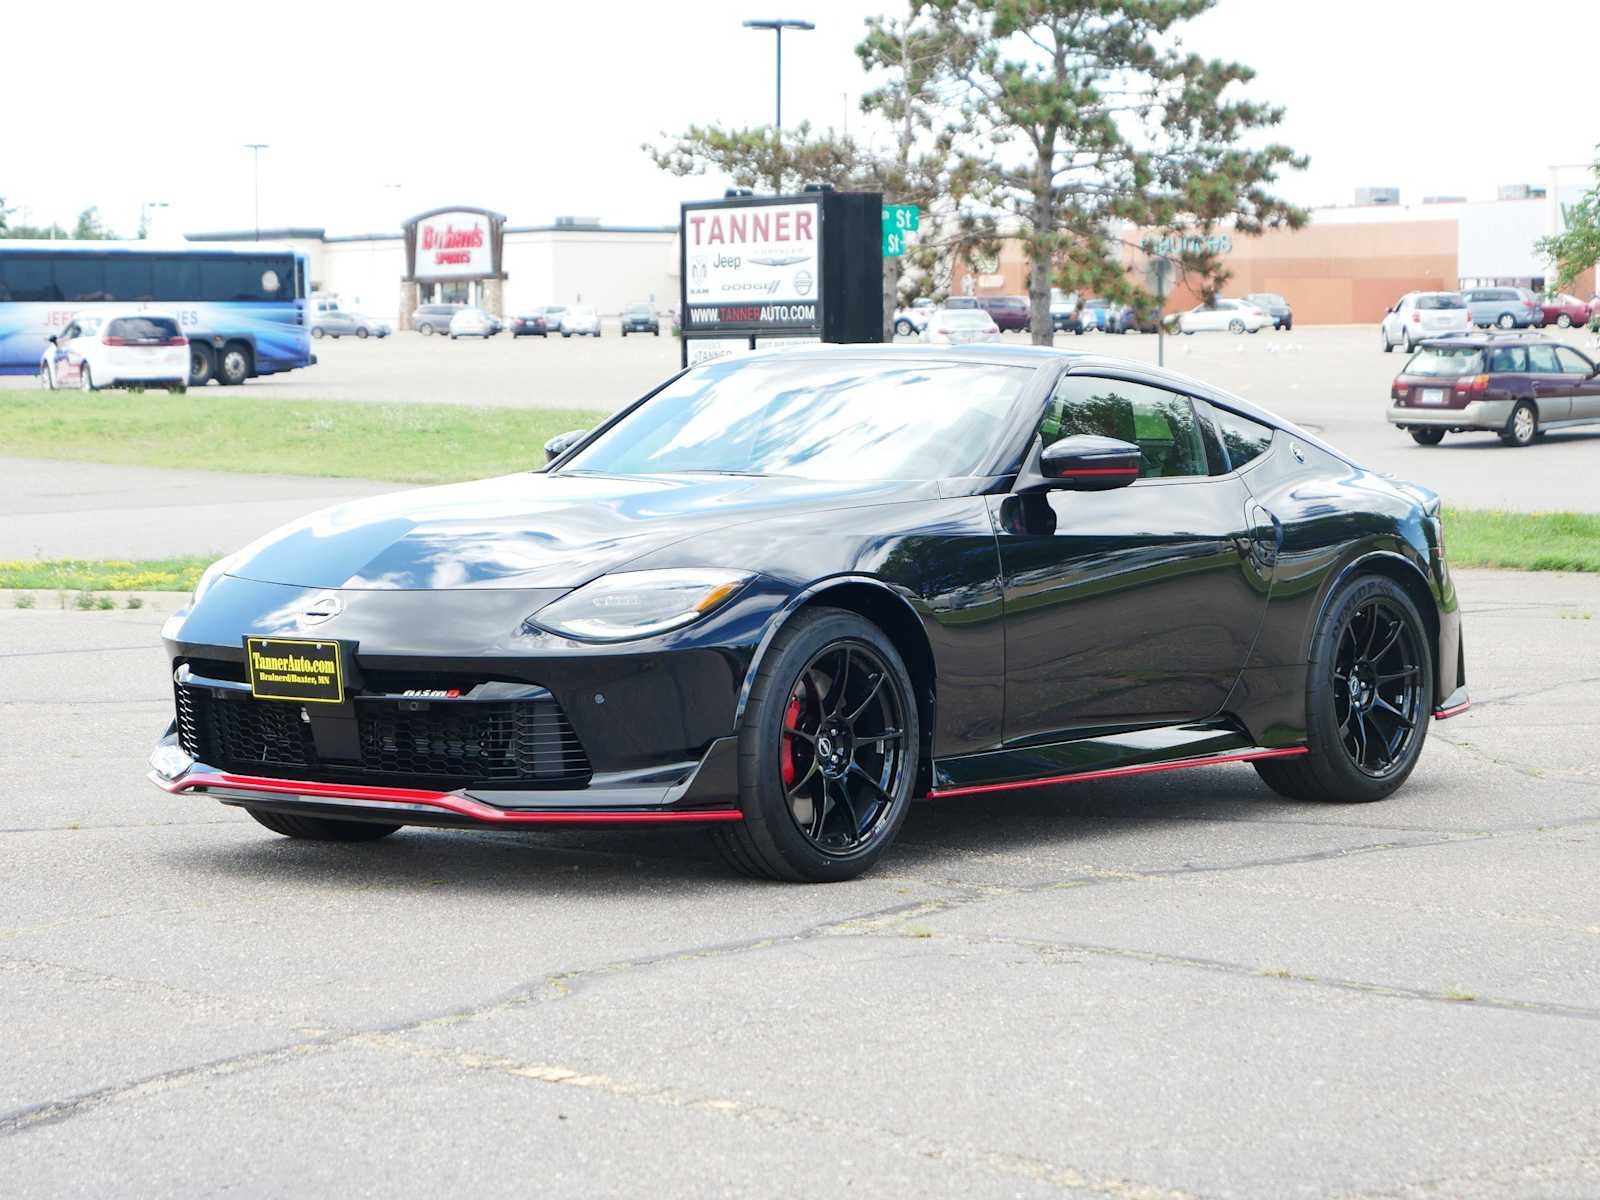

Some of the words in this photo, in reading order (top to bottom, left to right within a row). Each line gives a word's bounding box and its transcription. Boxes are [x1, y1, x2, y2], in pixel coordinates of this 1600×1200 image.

[690, 209, 814, 246] TANNER
[896, 209, 911, 228] St
[888, 233, 899, 252] St
[713, 253, 741, 270] Jeep
[690, 305, 816, 323] WWW.TANNERAUTO.COM
[252, 652, 335, 674] TannerAuto.com
